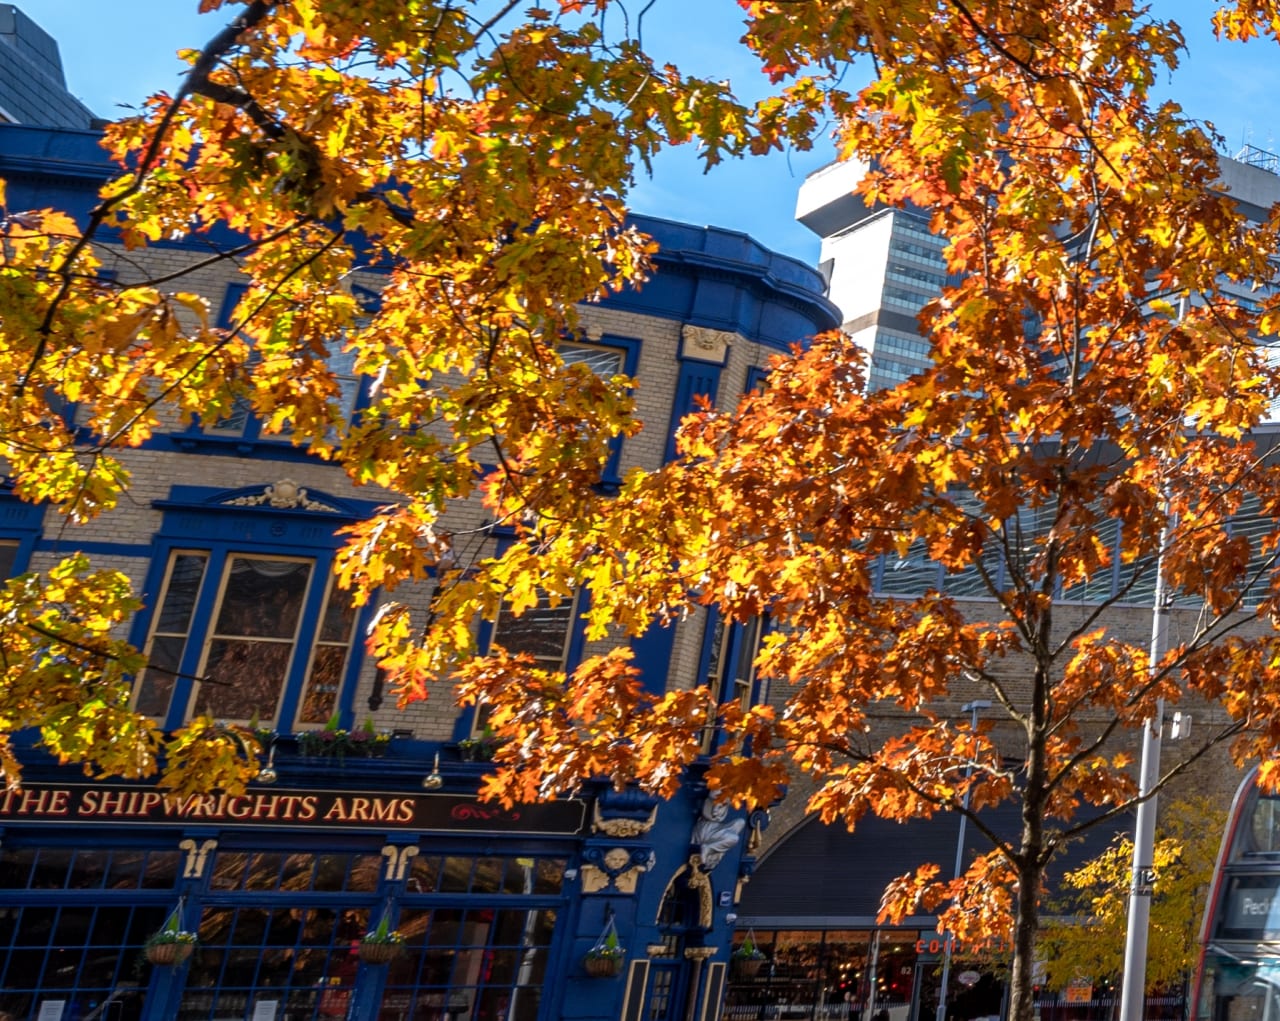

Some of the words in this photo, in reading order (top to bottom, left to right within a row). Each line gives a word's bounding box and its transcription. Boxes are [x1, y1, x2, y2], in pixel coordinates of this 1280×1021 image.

[0, 789, 71, 815] THE
[77, 790, 319, 820] SHIPWRIGHTS
[323, 797, 416, 822] ARMS
